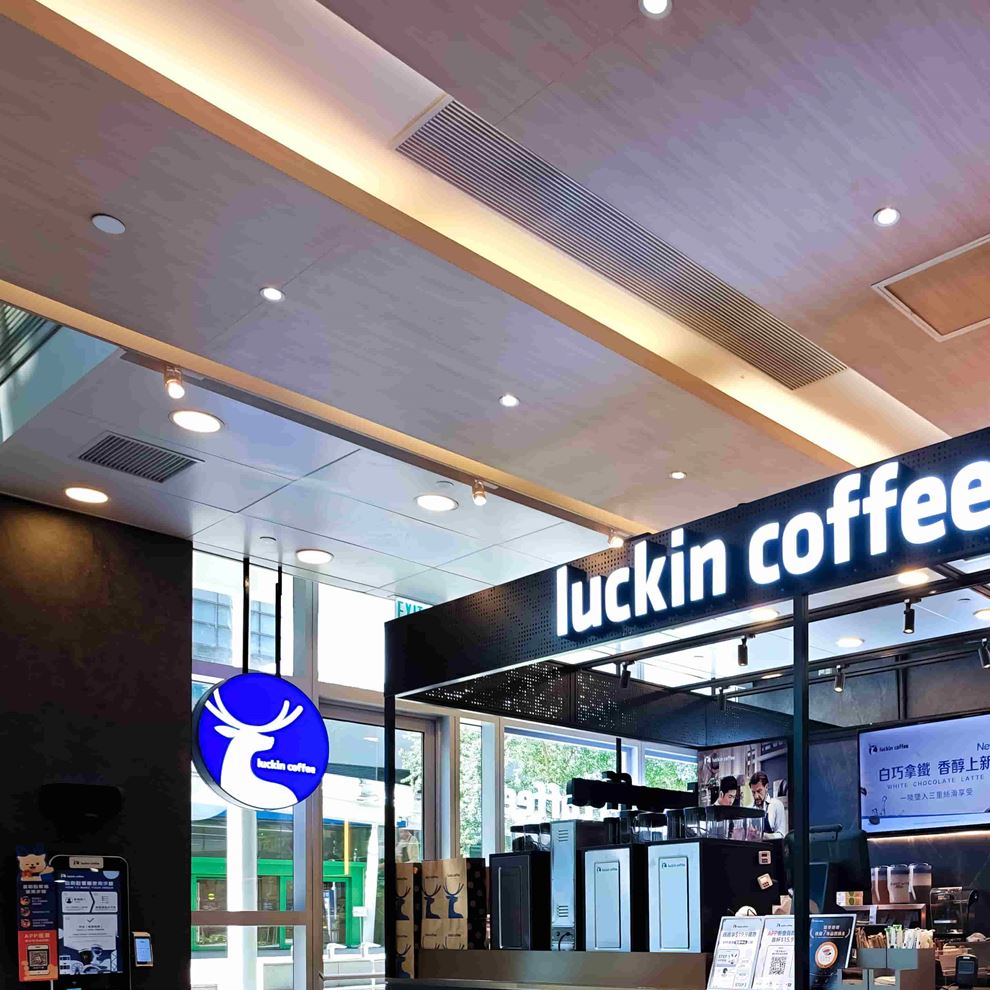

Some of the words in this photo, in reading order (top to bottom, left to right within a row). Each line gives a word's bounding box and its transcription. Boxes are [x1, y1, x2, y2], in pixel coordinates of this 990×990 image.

[556, 526, 727, 638] luckin
[257, 758, 286, 771] luckin
[287, 761, 316, 774] coffee
[879, 763, 931, 782] 白巧拿鐵
[912, 777, 955, 787] CHOCOLATE
[961, 774, 985, 782] LATTE
